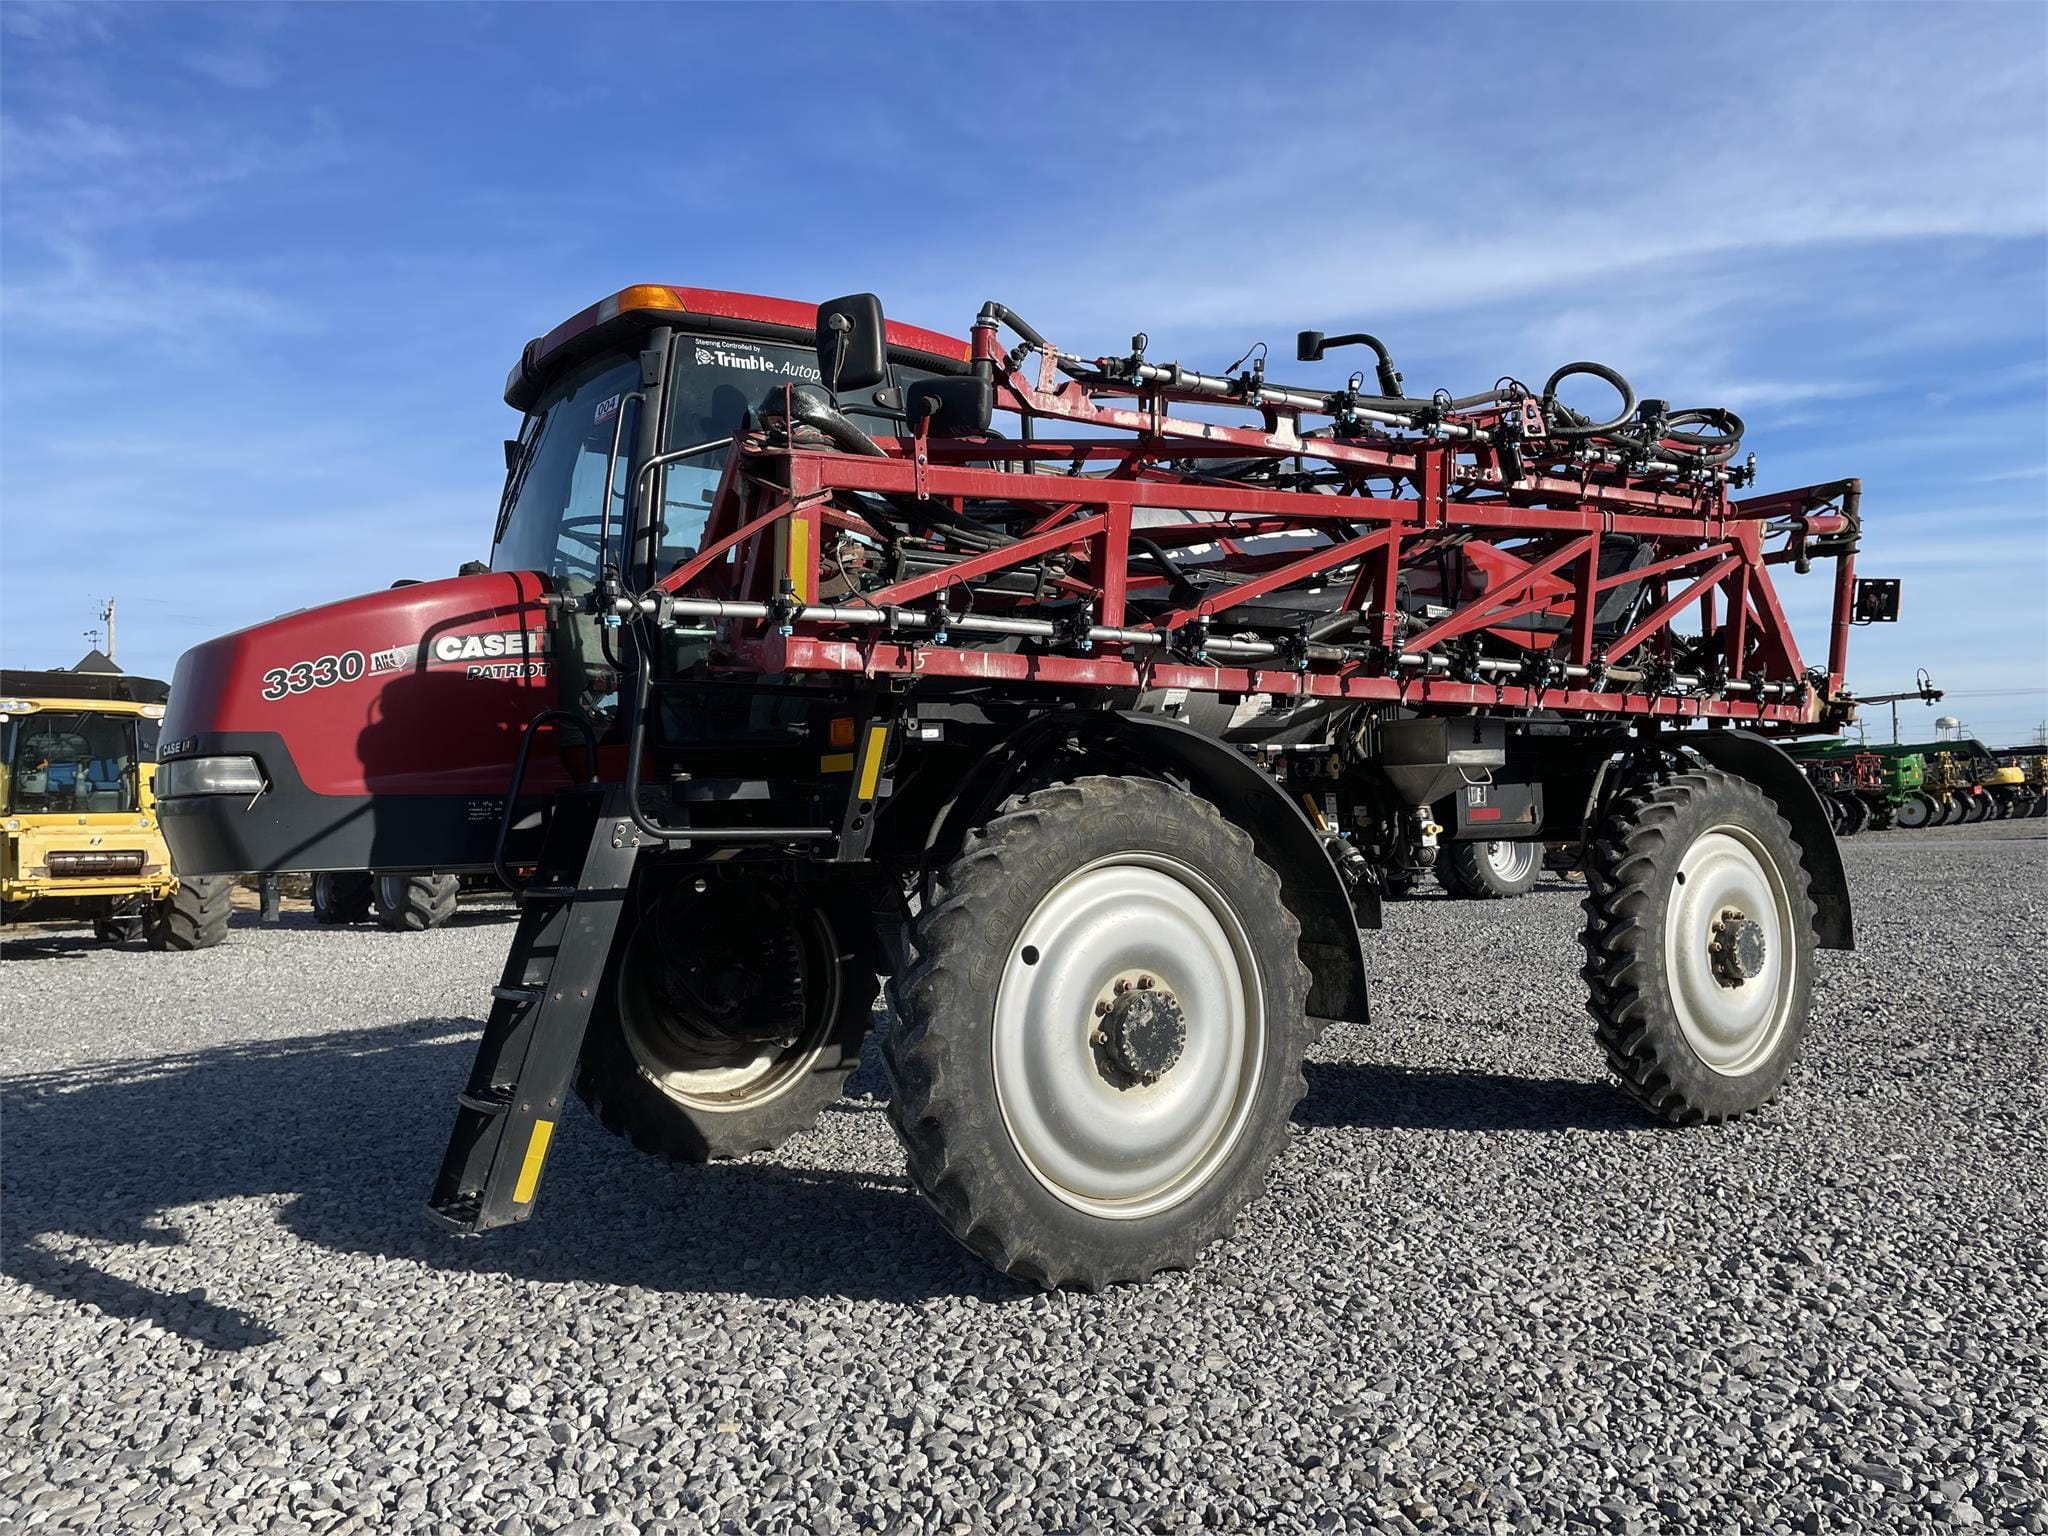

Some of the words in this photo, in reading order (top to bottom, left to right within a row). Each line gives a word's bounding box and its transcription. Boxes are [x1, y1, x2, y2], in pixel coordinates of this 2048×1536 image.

[695, 338, 721, 348] Steering
[721, 341, 752, 351] Controlled
[753, 345, 760, 353] by
[435, 634, 523, 660] CASE
[262, 650, 366, 701] 3330
[466, 662, 550, 680] PATRIOT
